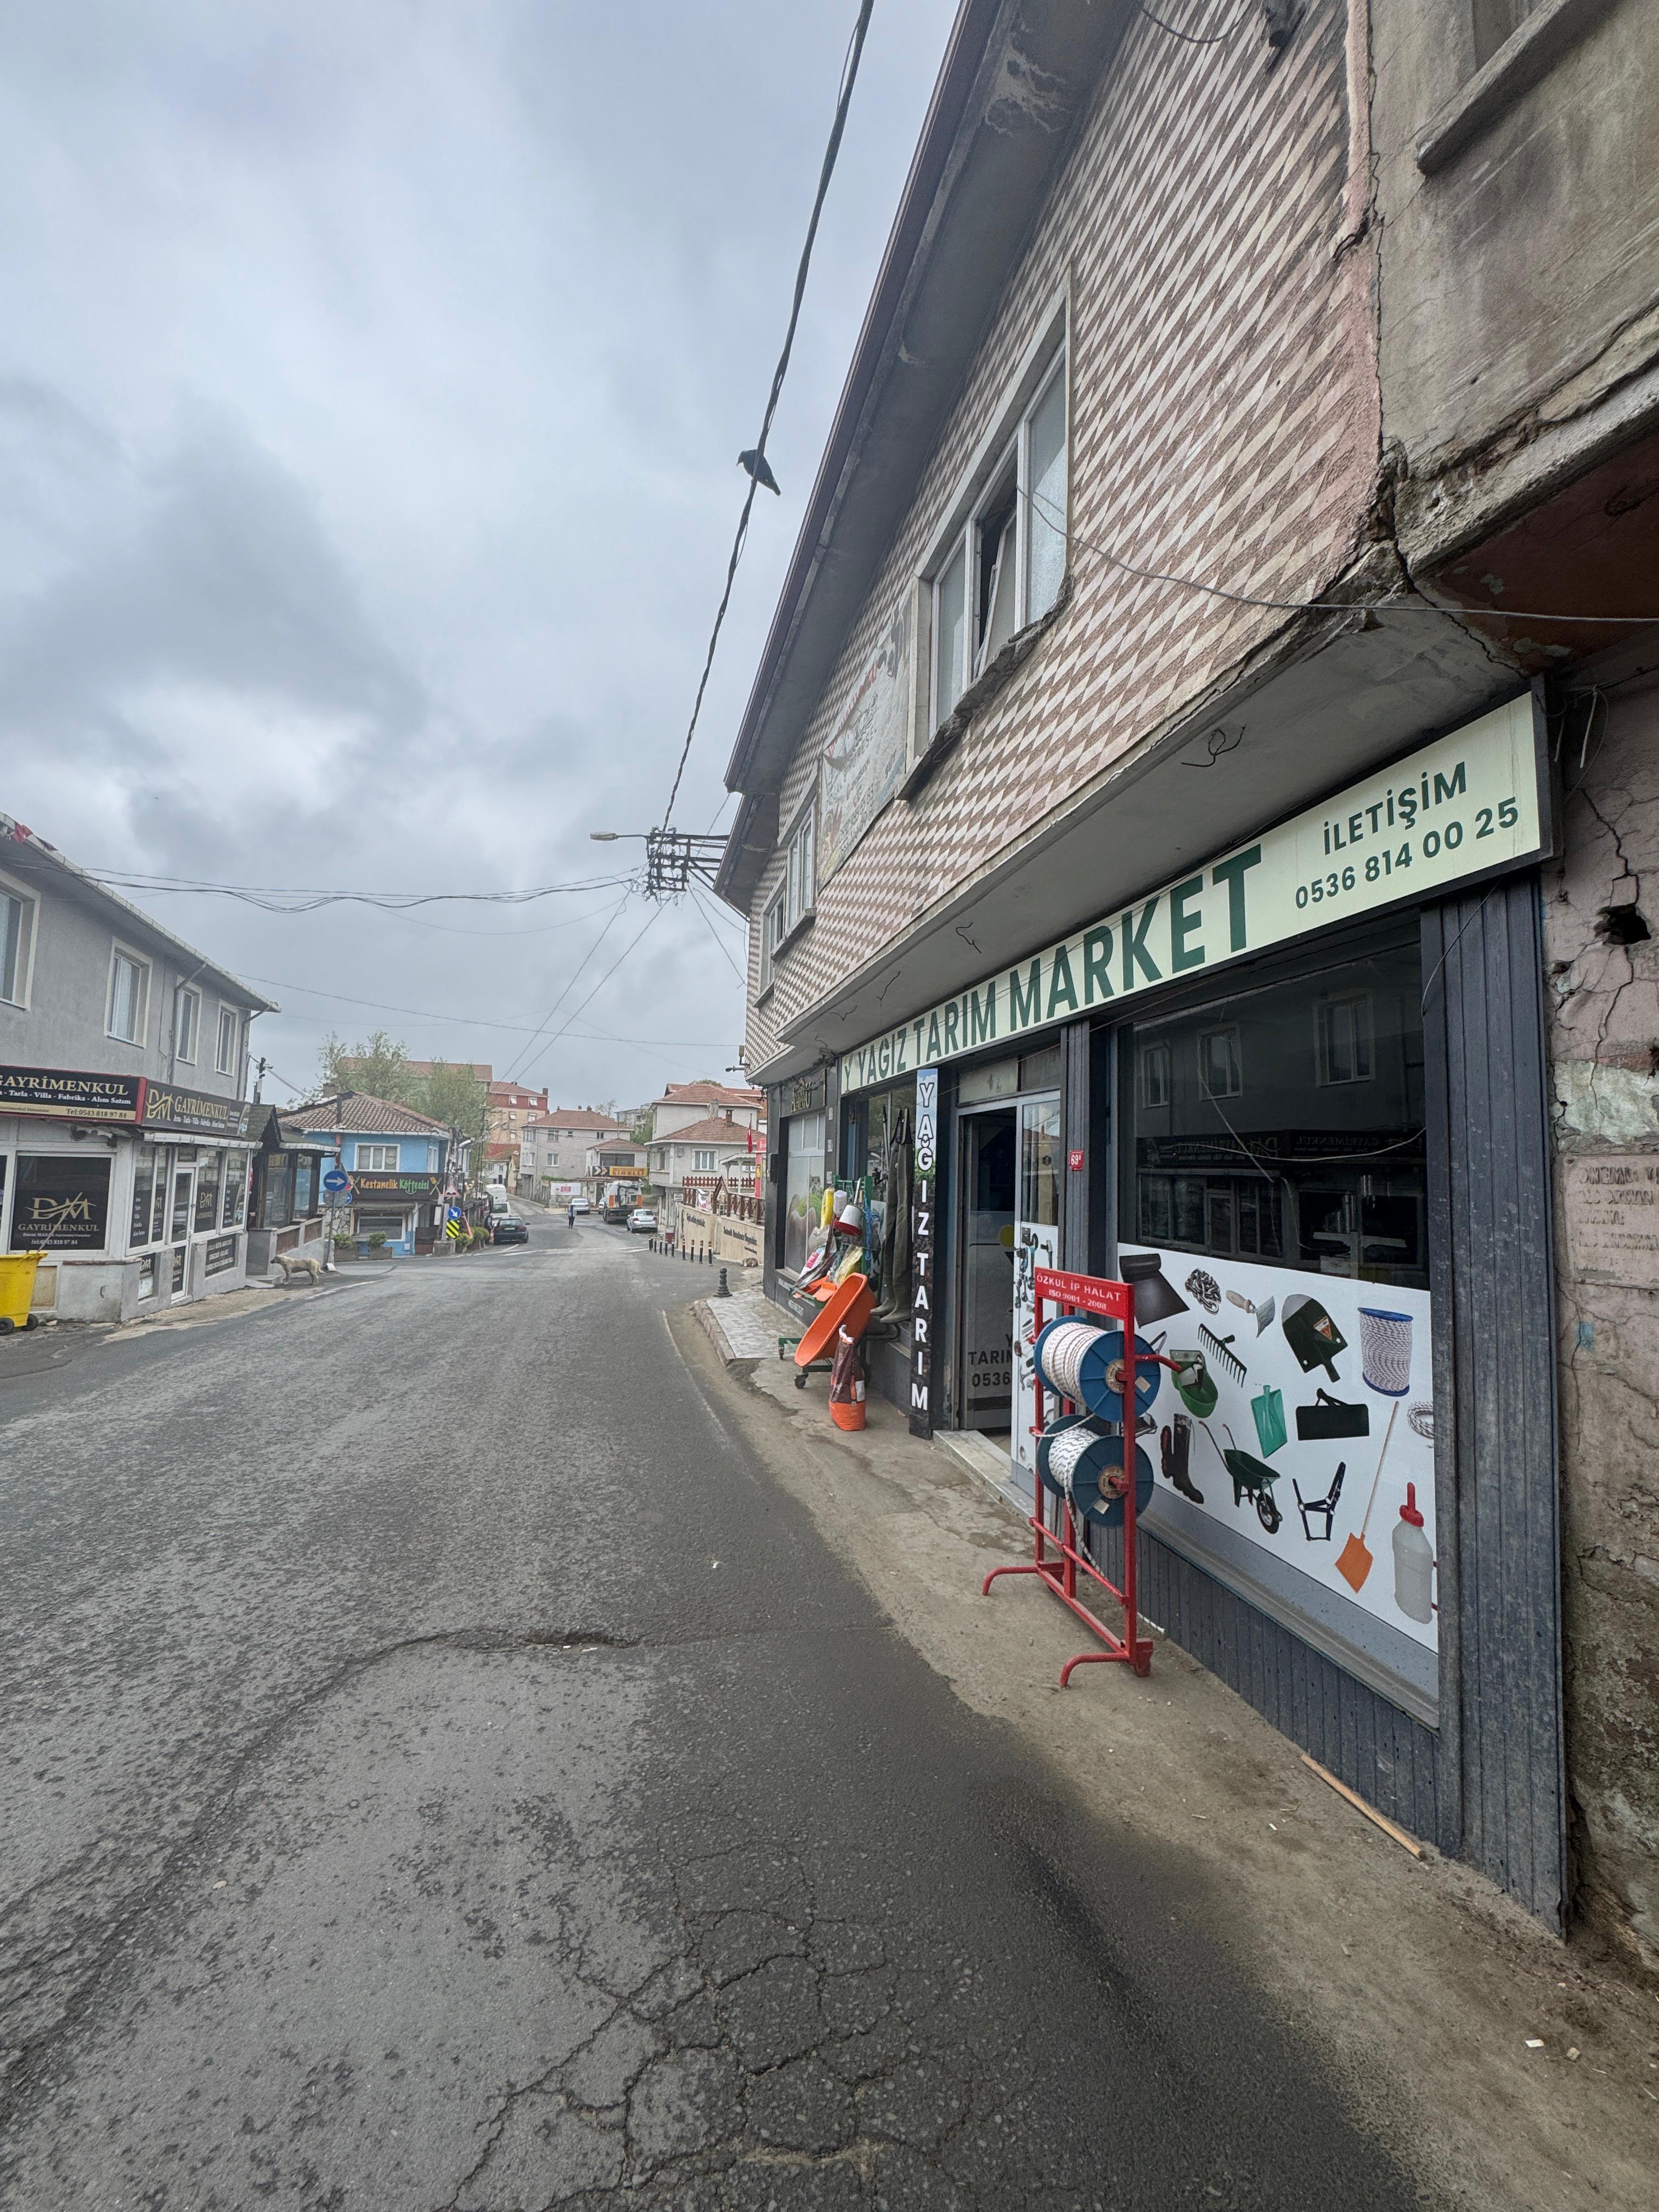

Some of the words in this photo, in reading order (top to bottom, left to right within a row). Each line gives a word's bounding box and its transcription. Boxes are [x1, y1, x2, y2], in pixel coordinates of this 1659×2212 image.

[1323, 761, 1466, 855] İLETİŞİM
[1295, 866, 1356, 909] 0536
[1364, 842, 1413, 882] 814
[1422, 821, 1464, 859] 00
[1475, 796, 1519, 840] 25
[857, 1027, 906, 1086] YAĞIZ
[913, 981, 996, 1066] TARIM
[1009, 844, 1261, 1031] MARKET
[174, 1096, 228, 1120] GAYRİMENKUL
[360, 1178, 398, 1189] Kestanelik
[399, 1178, 429, 1193] Köftecisi
[917, 1081, 934, 1235] YAĞIZ
[1036, 1272, 1066, 1289] ÖZKUL
[1070, 1279, 1080, 1291] İP
[1084, 1285, 1121, 1302] HALAT
[1048, 1289, 1061, 1298] ISO
[1062, 1293, 1080, 1304] 9001
[1087, 1299, 1107, 1310] 2008
[911, 1252, 929, 1411] TARIM
[971, 1371, 1011, 1387] 0536
